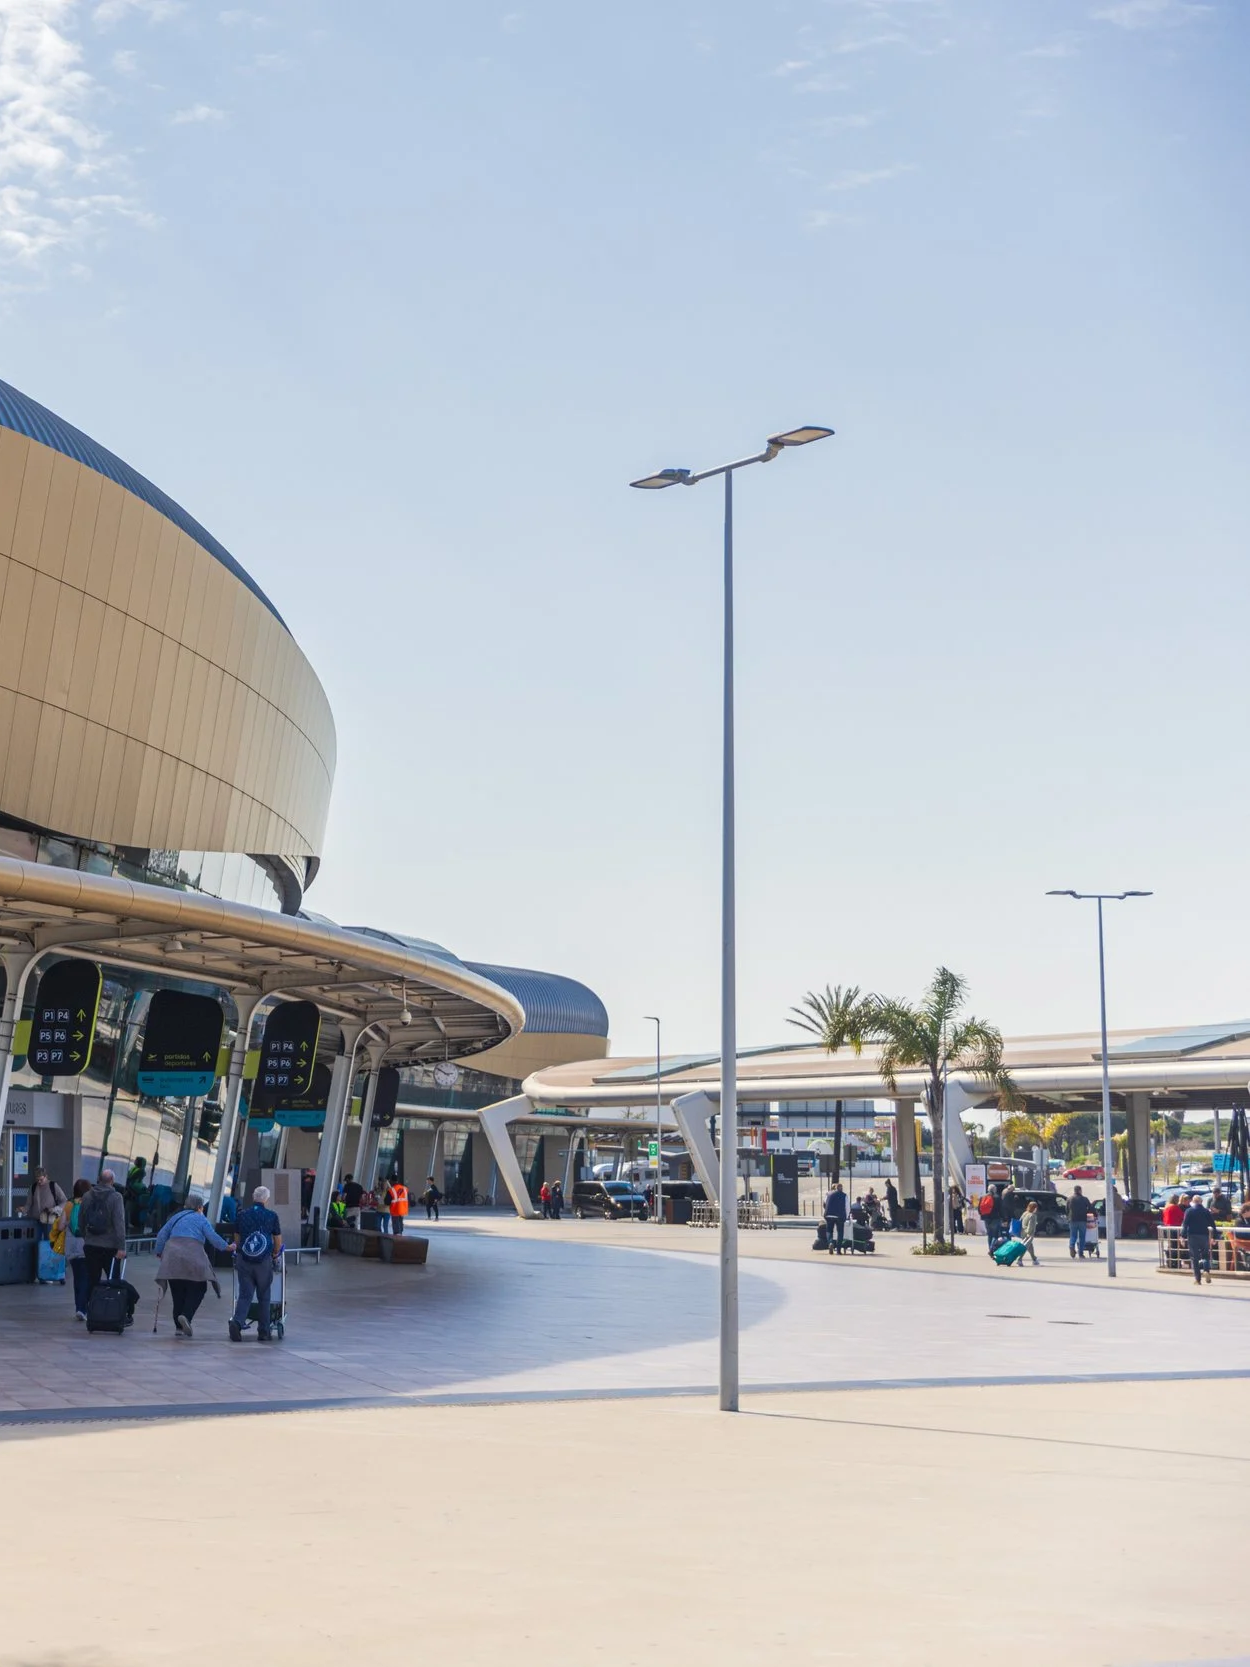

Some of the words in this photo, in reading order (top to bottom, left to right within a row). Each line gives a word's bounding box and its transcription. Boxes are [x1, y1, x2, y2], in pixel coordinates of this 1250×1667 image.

[44, 1011, 54, 1020] P1
[58, 1011, 68, 1020] P4
[40, 1031, 51, 1041] P5
[55, 1031, 66, 1041] P6
[37, 1052, 48, 1061] P3
[51, 1052, 62, 1061] P7
